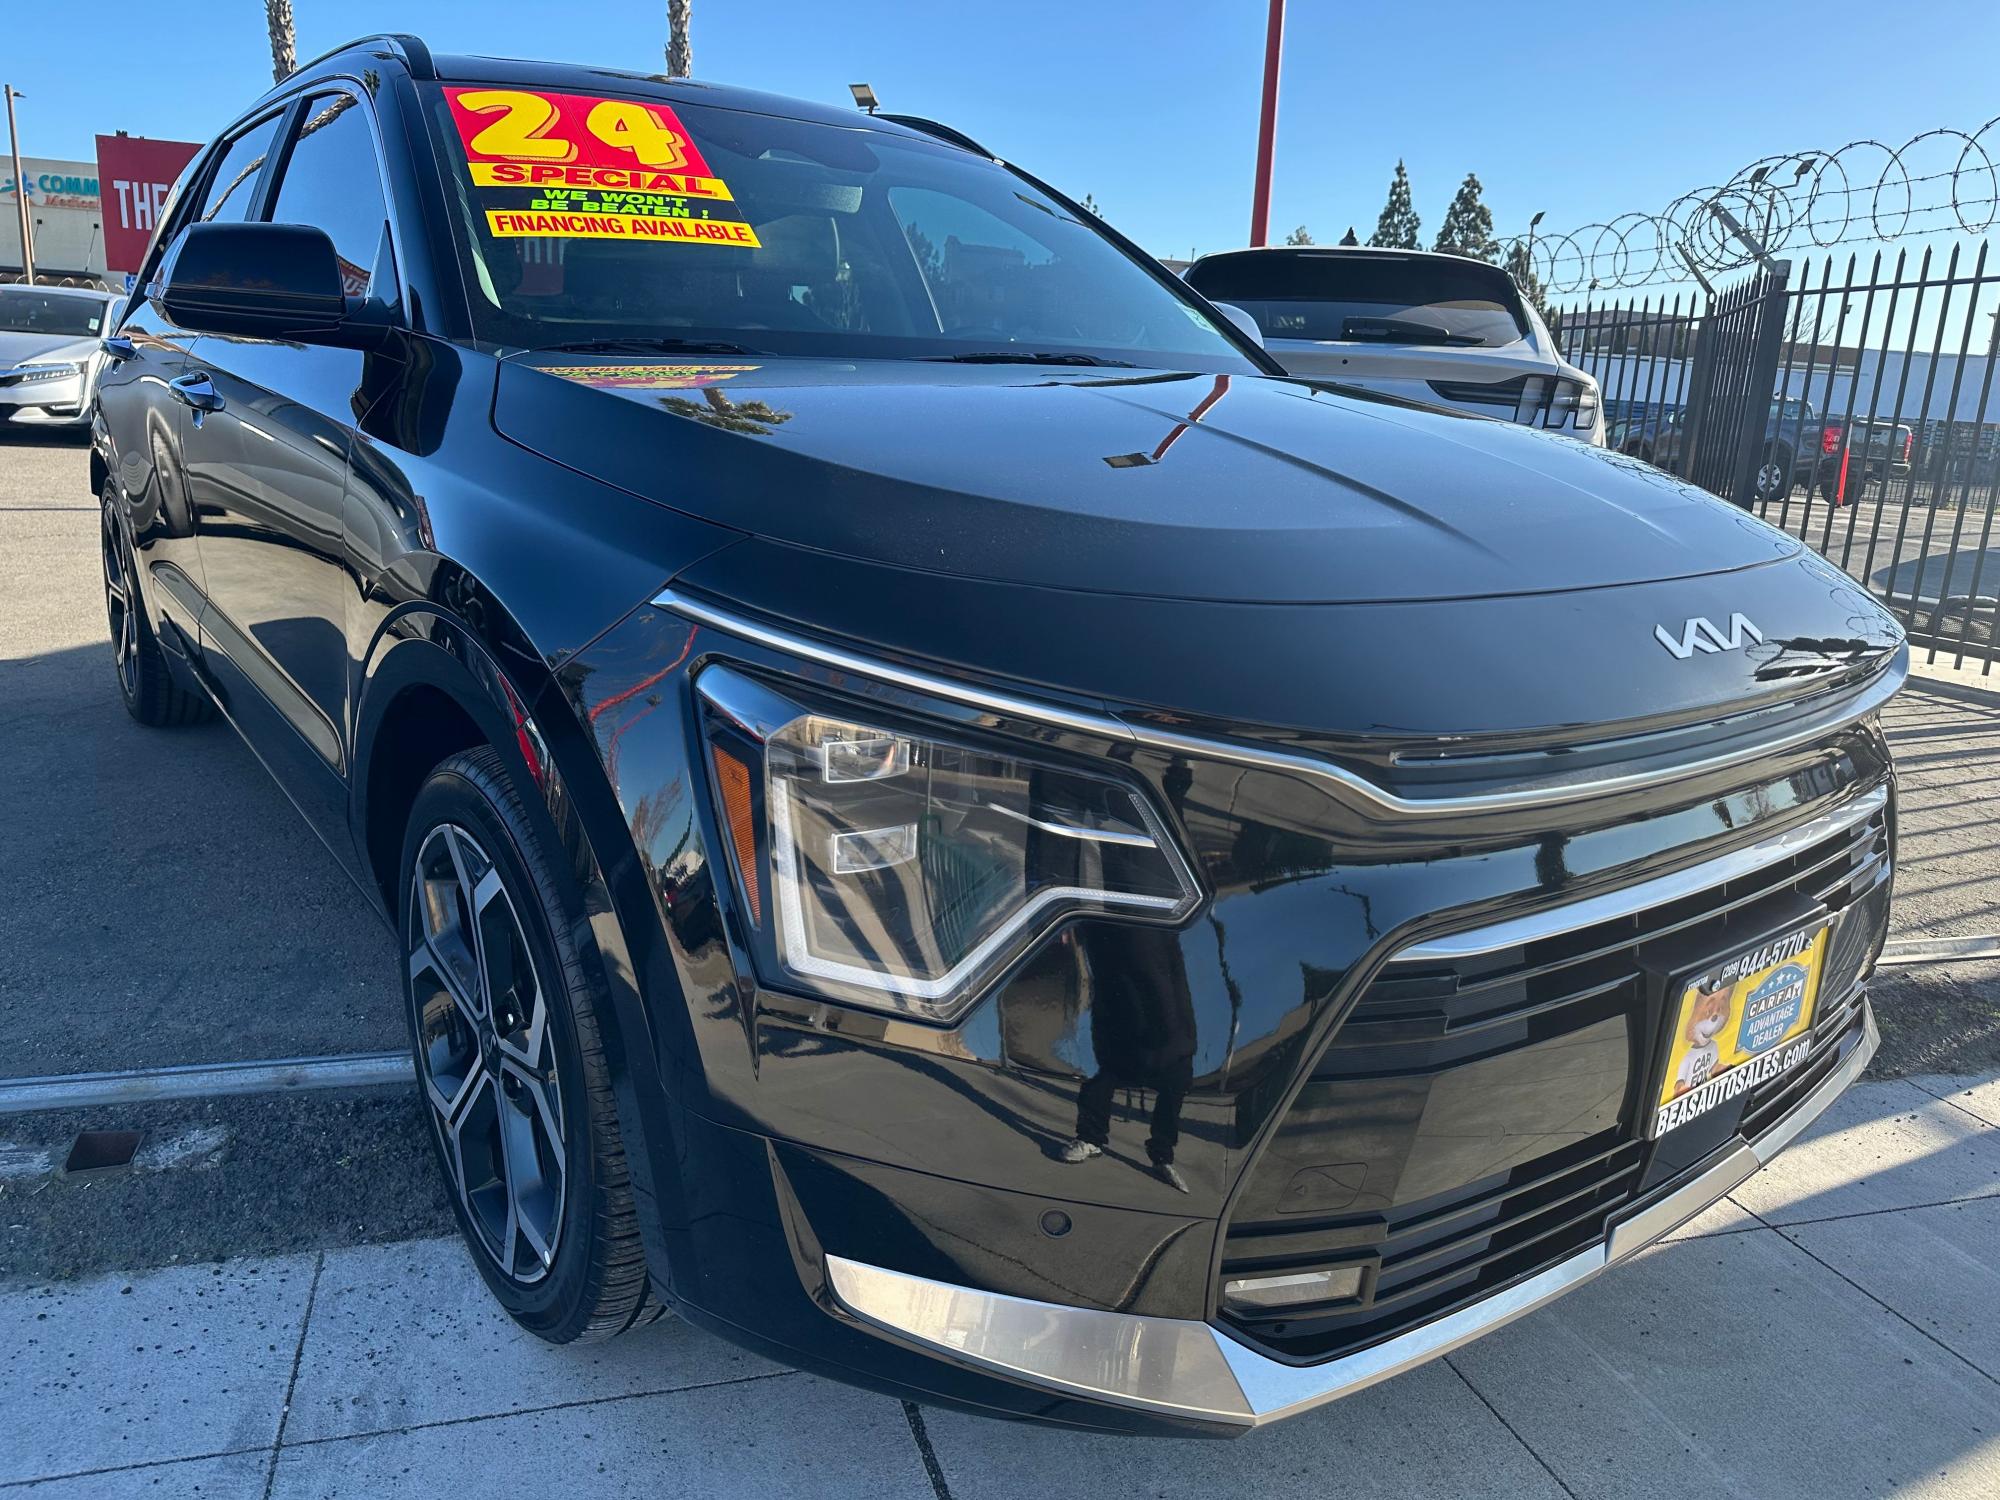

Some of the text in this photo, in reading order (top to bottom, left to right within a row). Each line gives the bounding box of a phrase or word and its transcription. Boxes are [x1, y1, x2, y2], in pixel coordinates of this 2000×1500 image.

[457, 90, 687, 169] 24
[491, 165, 716, 197] SPECIAL
[530, 199, 569, 211] BE
[582, 201, 690, 218] BEATEN
[543, 189, 688, 208] WE WON'T
[494, 214, 752, 243] FINANCING AVAILABLE
[1738, 930, 1806, 981] 944-5770
[1749, 983, 1802, 1017] CARFAX
[1747, 1003, 1796, 1037] ADVANTAGE
[1752, 1022, 1784, 1049] DEALER
[1692, 1052, 1712, 1074] CAR
[1655, 1038, 1811, 1139] BEASAUTOSALES.com
